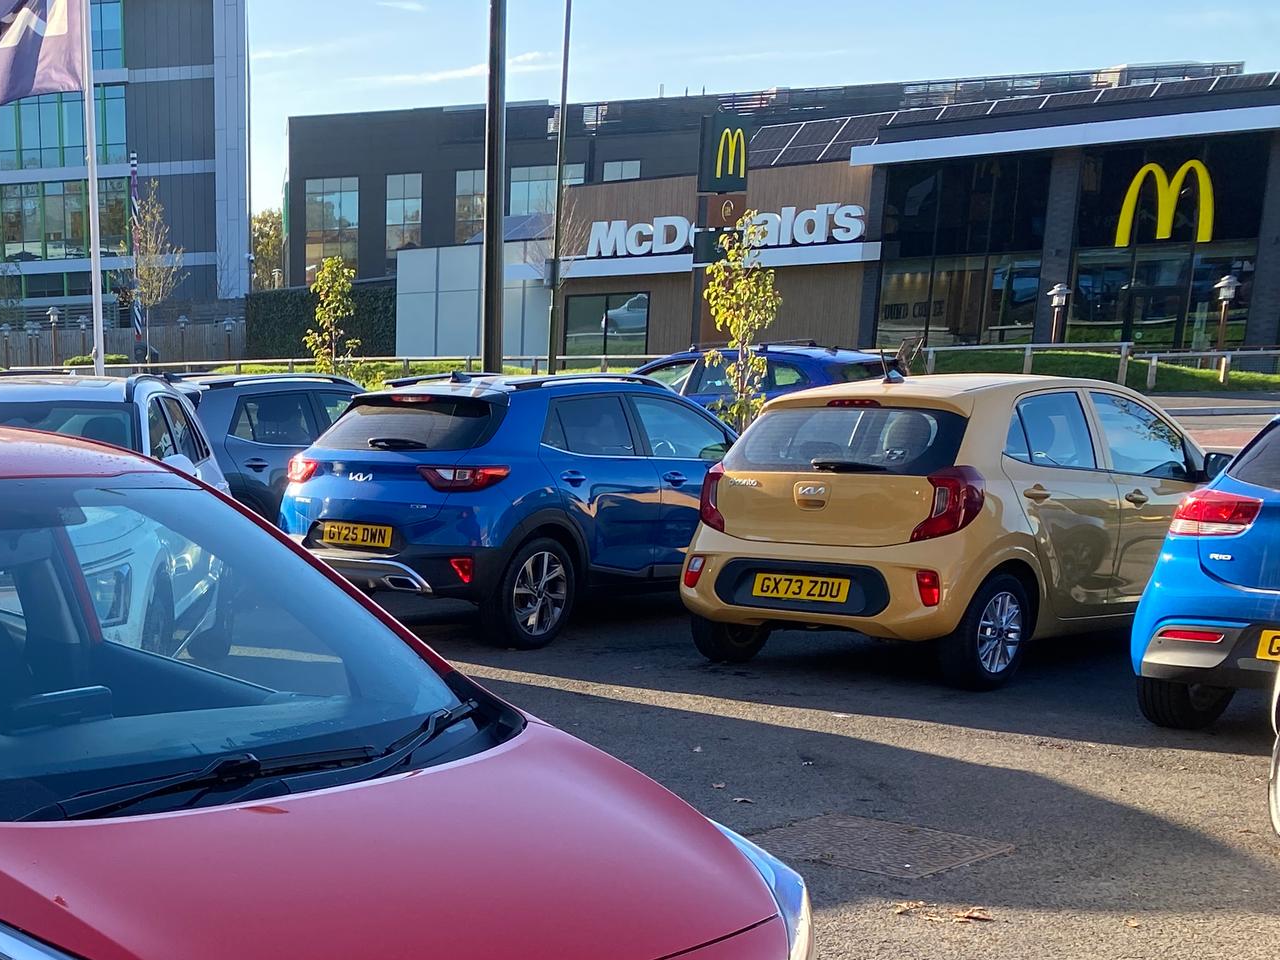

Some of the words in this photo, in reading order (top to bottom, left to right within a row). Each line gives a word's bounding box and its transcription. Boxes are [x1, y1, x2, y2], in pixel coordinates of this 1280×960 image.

[328, 525, 358, 541] GY25
[361, 528, 386, 544] DWN
[761, 577, 802, 595] GX73
[807, 580, 842, 598] ZDU
